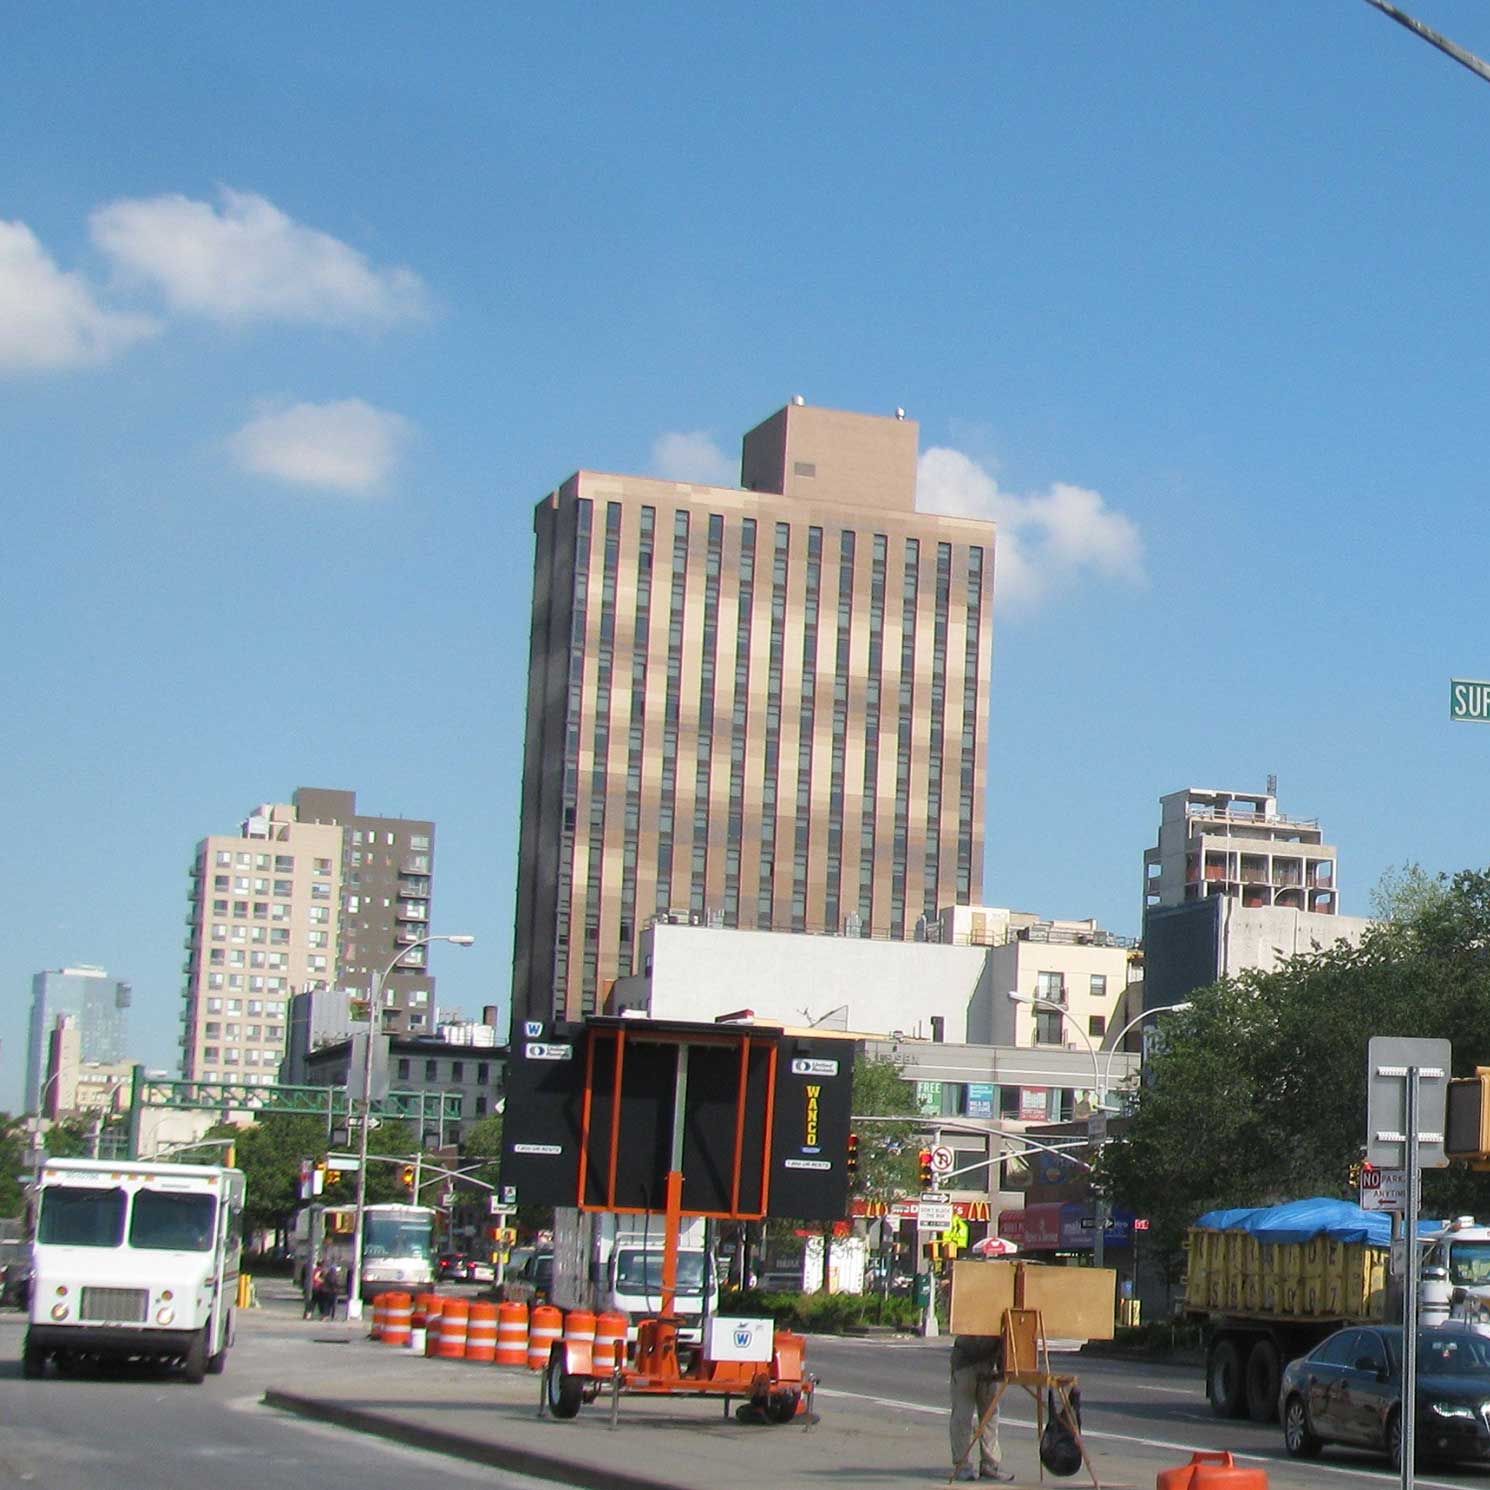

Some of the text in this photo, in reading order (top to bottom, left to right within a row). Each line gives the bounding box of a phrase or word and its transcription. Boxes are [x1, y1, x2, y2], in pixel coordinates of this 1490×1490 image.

[918, 1082, 941, 1093] FREE
[806, 1086, 821, 1146] WANCO
[1363, 1172, 1407, 1186] NO PARKI
[1374, 1190, 1407, 1198] ANYTIM
[737, 1333, 749, 1345] W
